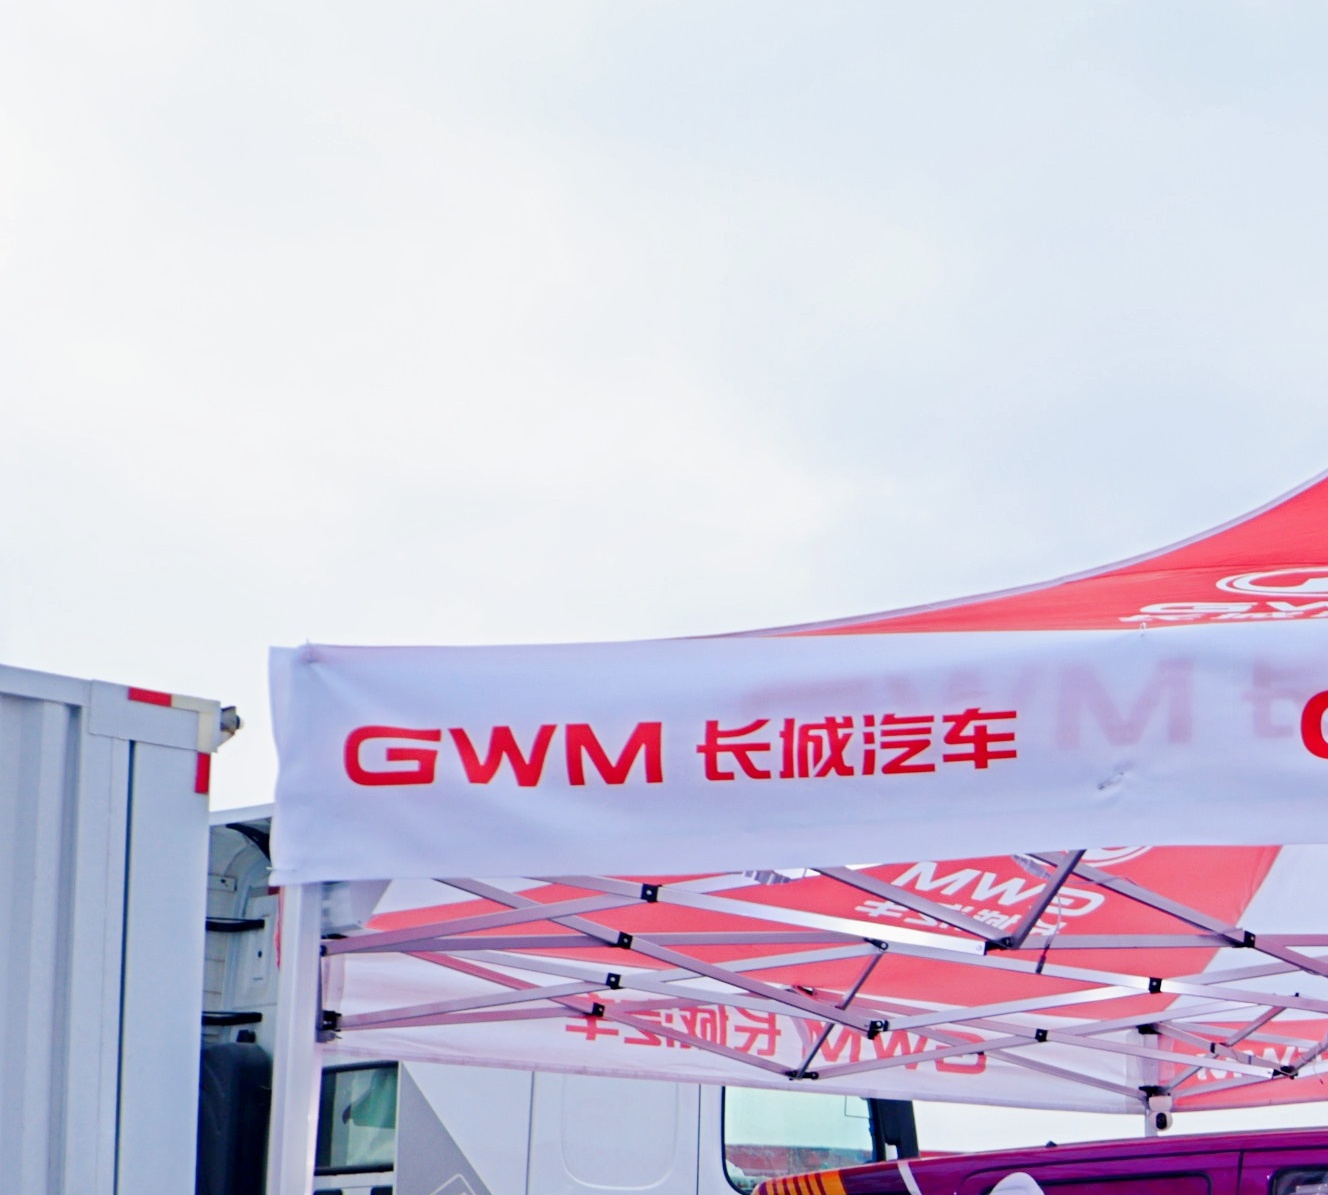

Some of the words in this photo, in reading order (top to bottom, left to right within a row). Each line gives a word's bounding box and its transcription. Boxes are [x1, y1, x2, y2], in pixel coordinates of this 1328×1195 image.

[343, 721, 664, 787] GWM
[698, 708, 1018, 782] 长城汽车
